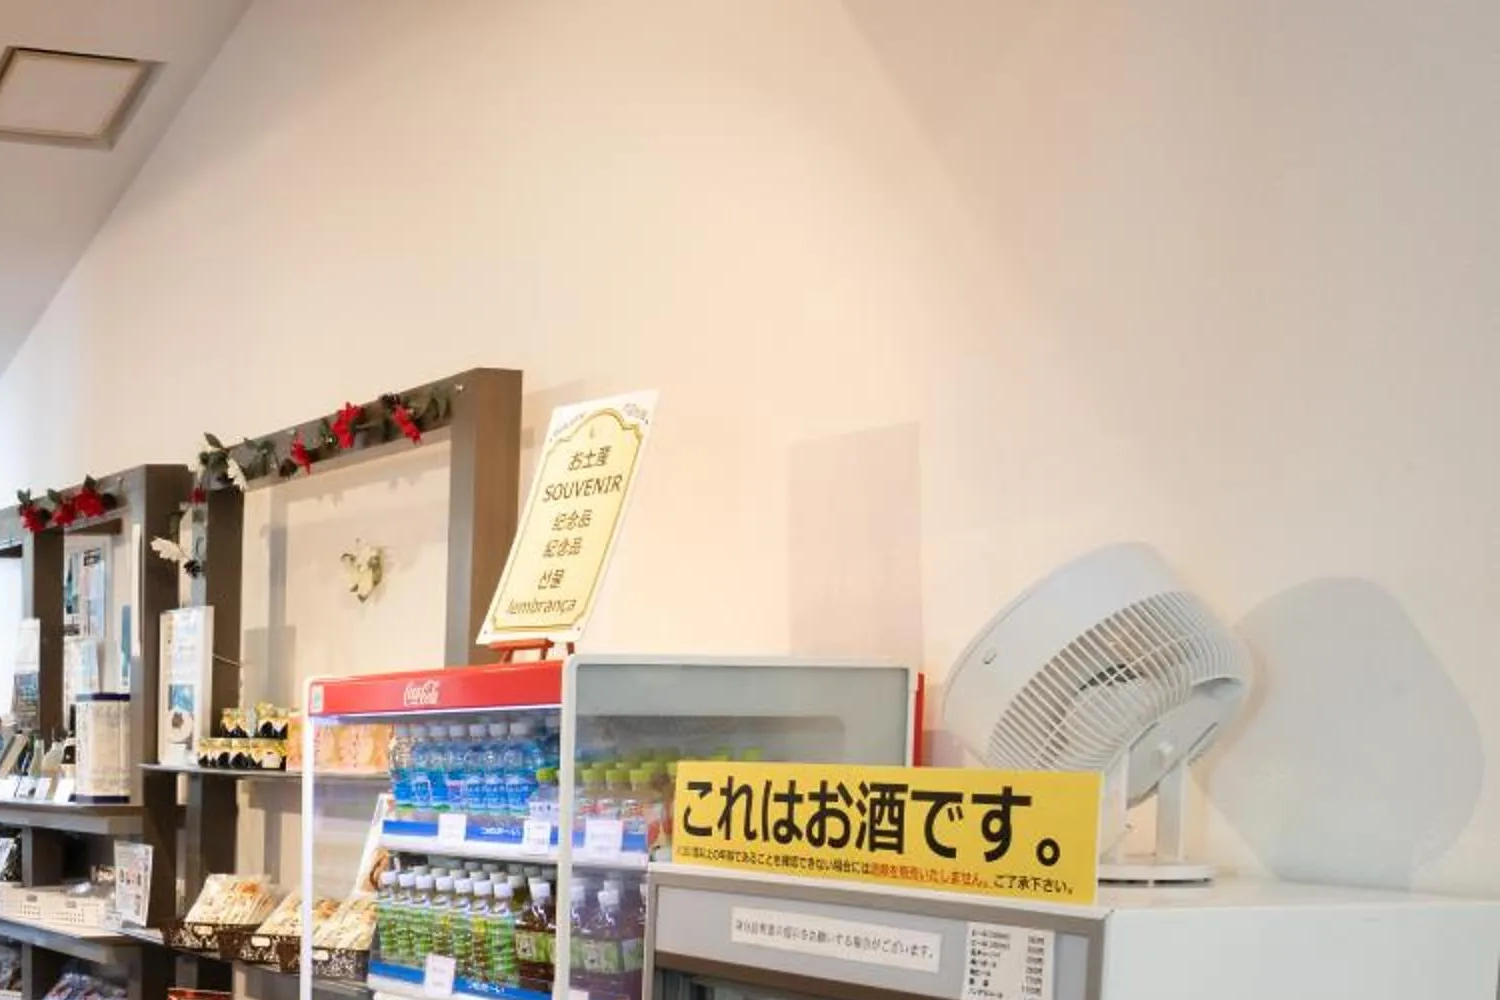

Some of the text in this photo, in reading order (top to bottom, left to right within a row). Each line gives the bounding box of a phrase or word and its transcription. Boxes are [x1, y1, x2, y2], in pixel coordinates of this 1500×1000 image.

[567, 445, 611, 472] お土産
[542, 474, 623, 503] SOUVENIR
[507, 597, 578, 617] lembrança
[682, 775, 1061, 868] これはお酒です。
